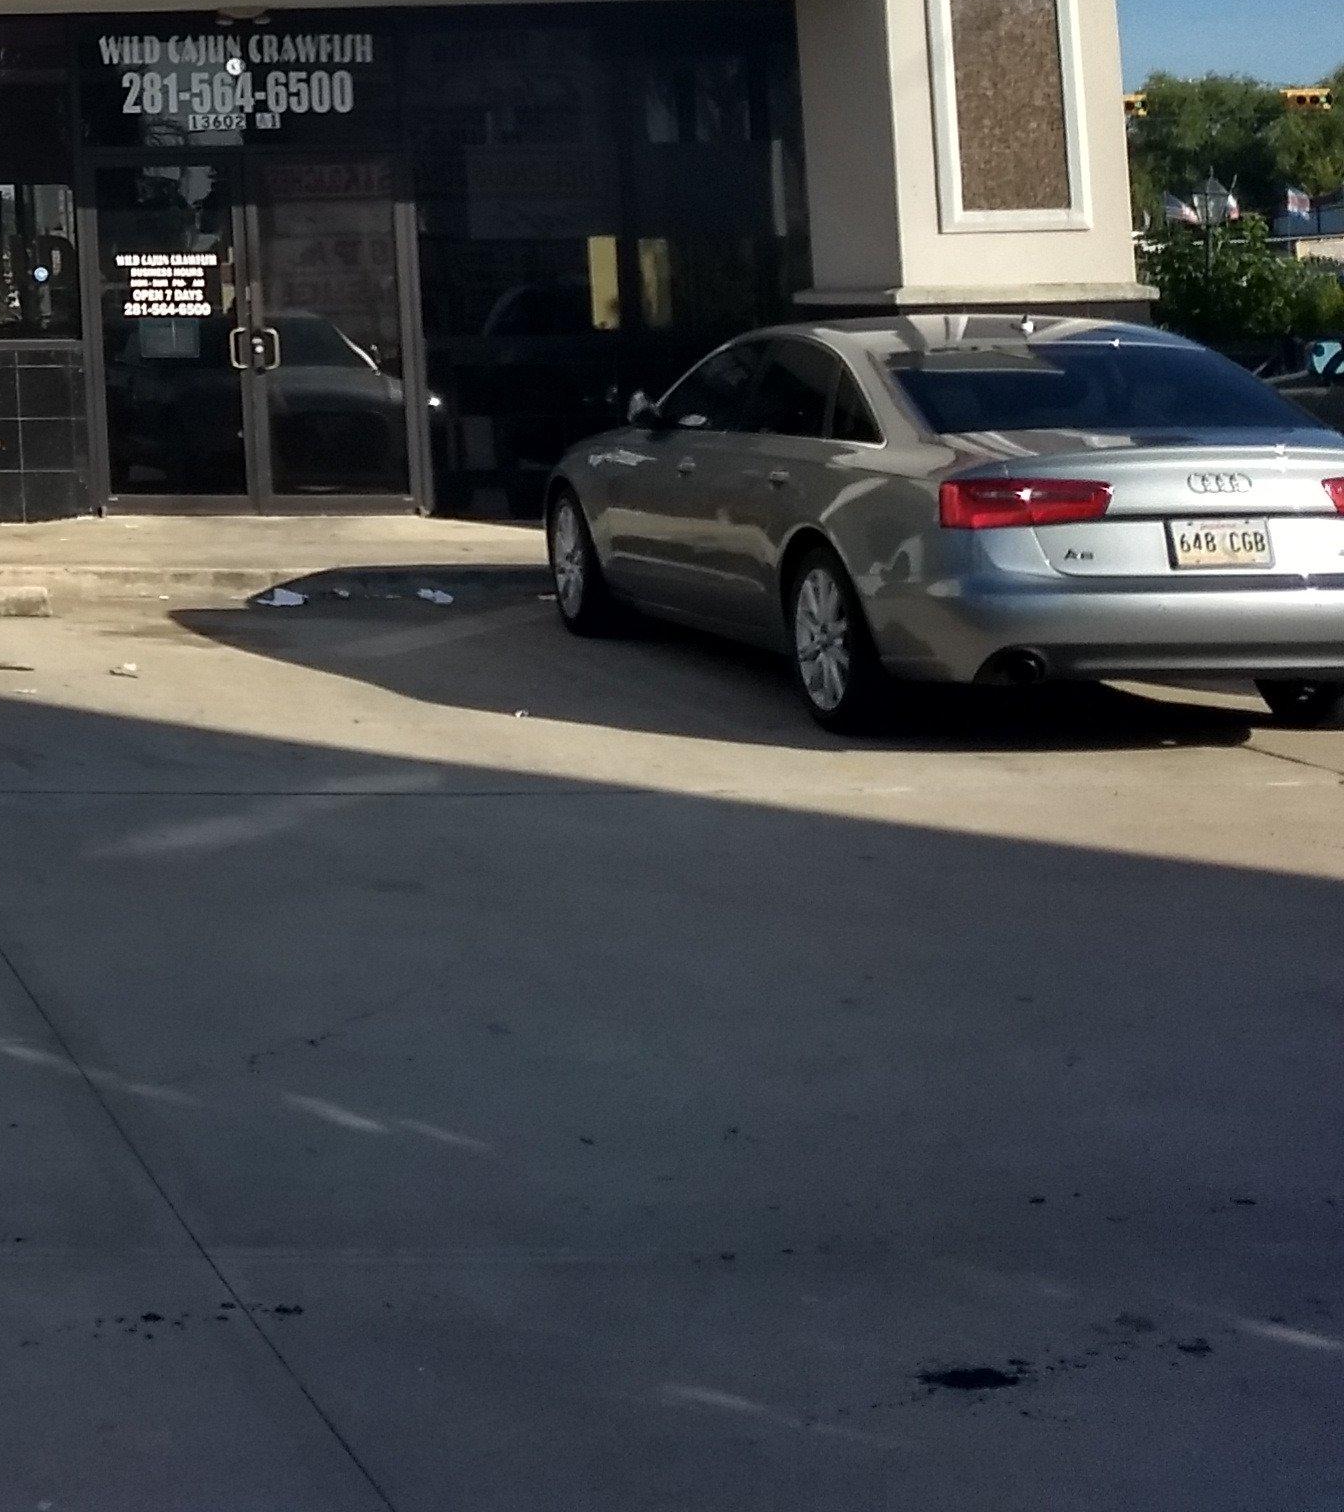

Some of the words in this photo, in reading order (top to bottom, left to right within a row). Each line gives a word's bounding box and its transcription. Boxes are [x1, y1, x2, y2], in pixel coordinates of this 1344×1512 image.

[98, 35, 160, 65] WILD
[168, 34, 242, 66] CAJUN
[248, 34, 373, 64] CRAWFISH
[122, 70, 354, 114] 281-564-6500
